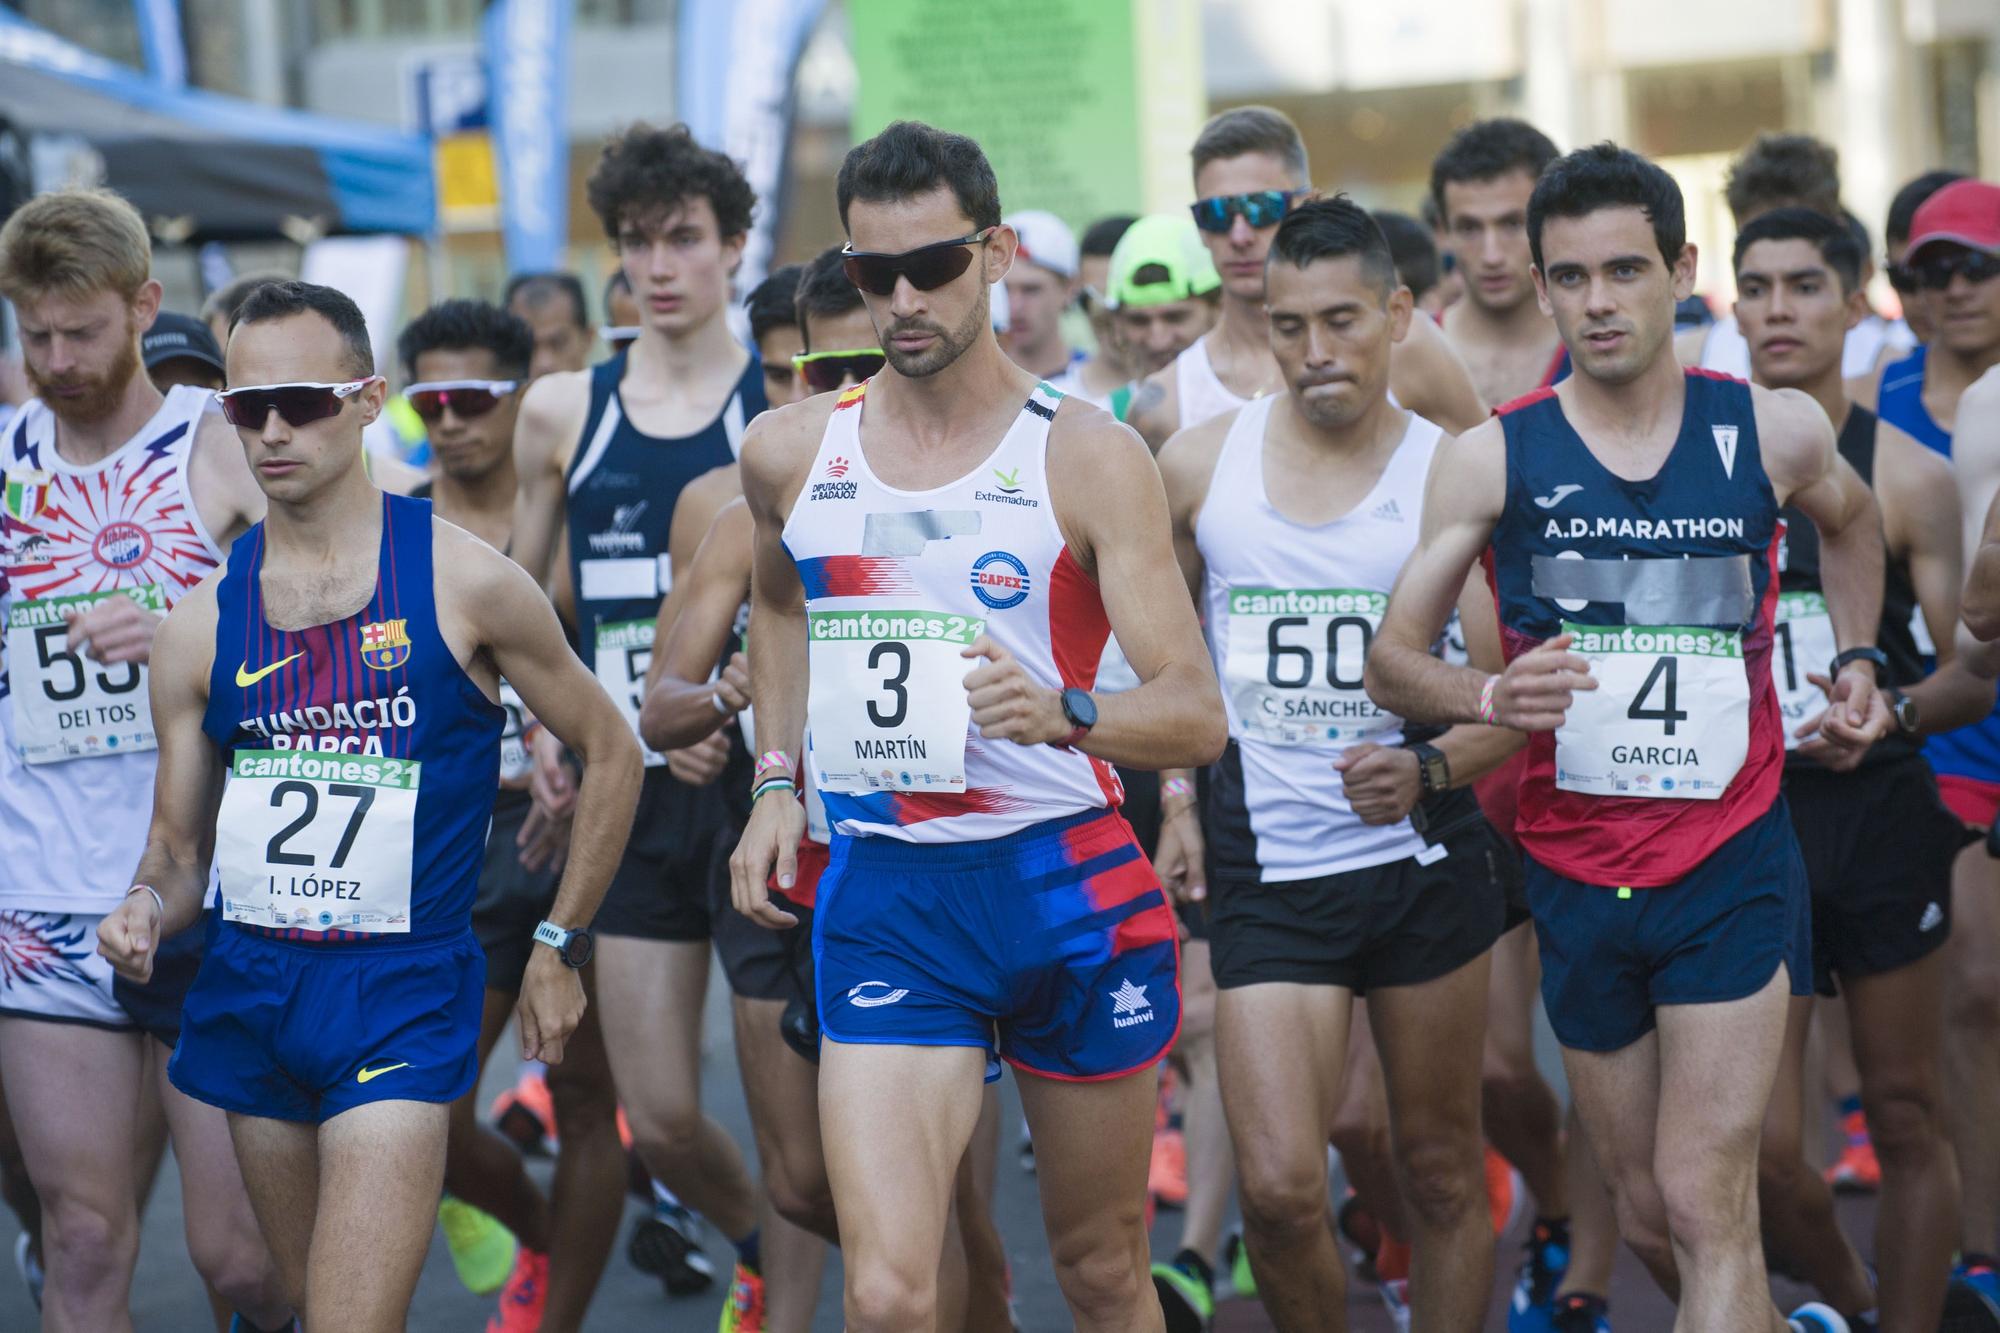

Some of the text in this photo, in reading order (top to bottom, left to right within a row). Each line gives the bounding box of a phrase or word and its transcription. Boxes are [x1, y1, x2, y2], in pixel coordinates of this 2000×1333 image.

[813, 480, 858, 493] DIPUTACIÓN
[819, 490, 856, 500] BADAJOZ
[975, 491, 1038, 507] Extremadura
[1545, 518, 1744, 539] A.D.MARATHON
[980, 573, 1022, 589] CAPEX
[11, 584, 166, 626] canton21
[1234, 591, 1388, 615] cantones2
[814, 612, 985, 642] cantones21
[1267, 617, 1373, 690] 60
[1569, 627, 1743, 657] cantones21
[866, 642, 911, 728] 3
[1627, 656, 1688, 736] 4
[59, 703, 136, 730] DEI TOS
[855, 734, 927, 759] MARTÍN
[1611, 746, 1699, 766] GARCIA
[238, 752, 421, 789] cantones21
[266, 780, 376, 869] 27
[269, 873, 361, 900] I. LÓPEZ
[1114, 1009, 1154, 1028] luanvi
